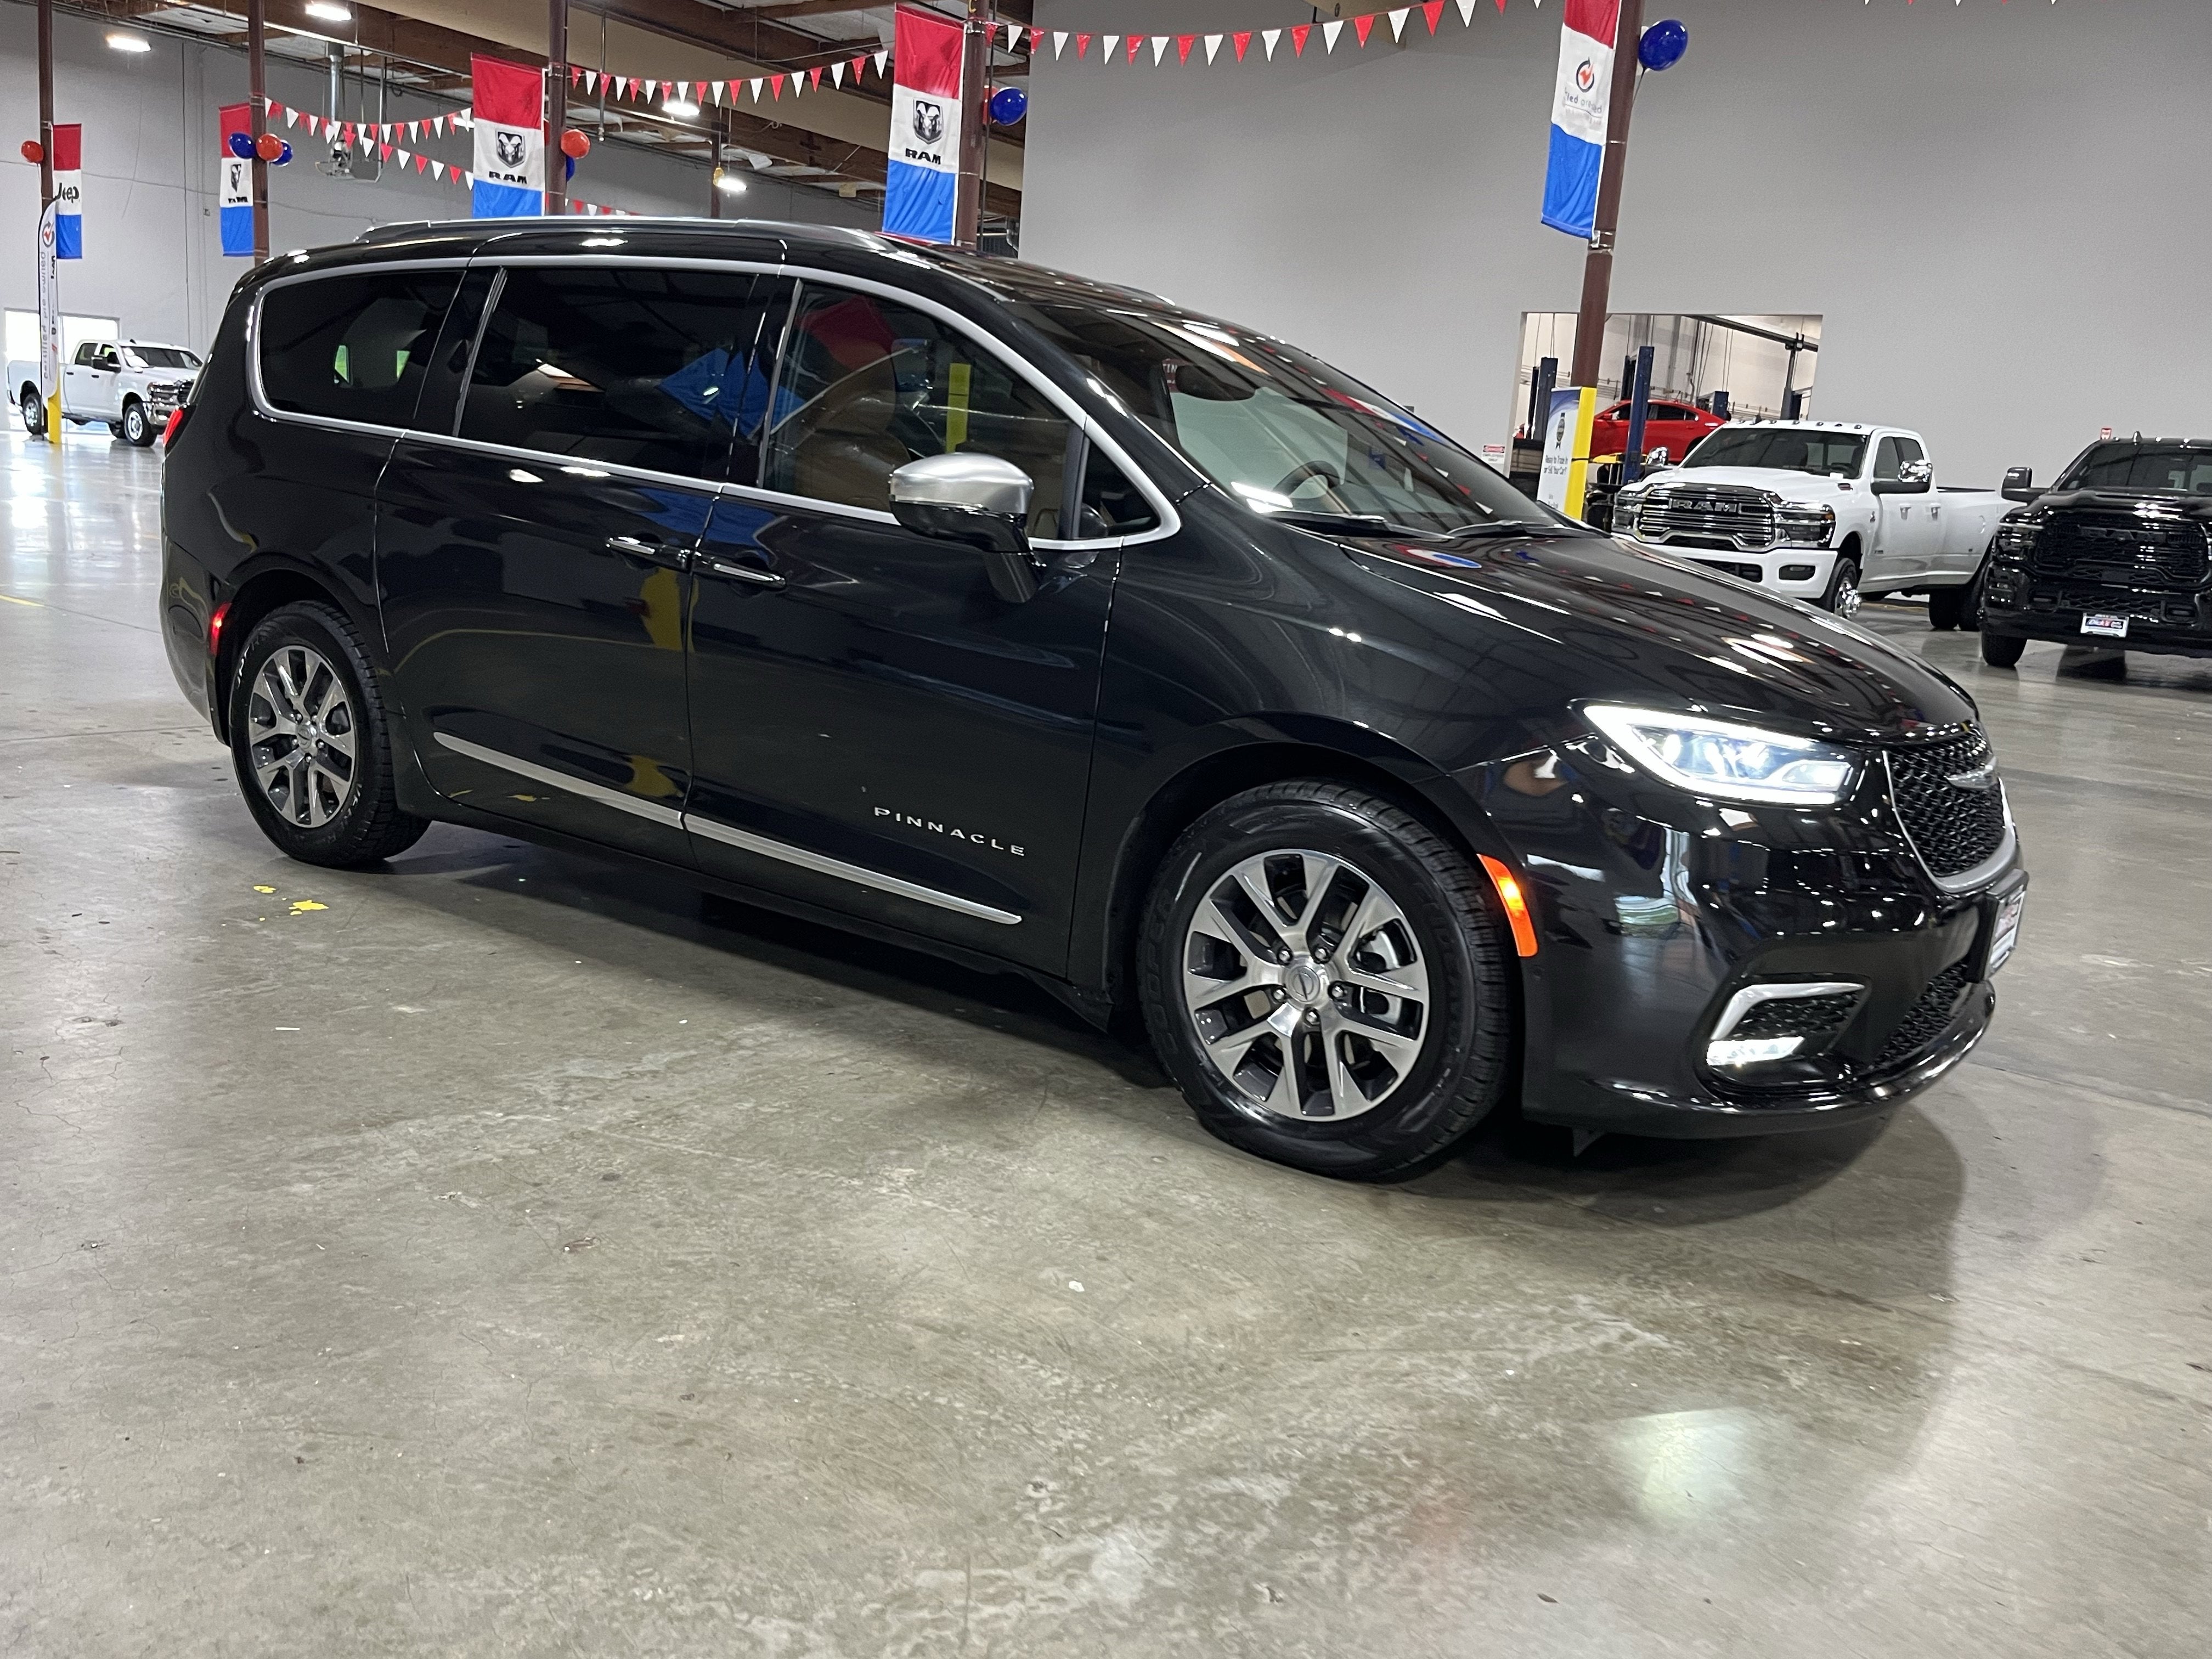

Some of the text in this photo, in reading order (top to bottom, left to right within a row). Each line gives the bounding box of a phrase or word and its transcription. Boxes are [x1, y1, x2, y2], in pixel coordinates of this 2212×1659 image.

[905, 148, 941, 165] RAM
[489, 171, 528, 185] RAM
[1672, 499, 1737, 512] RAM
[874, 806, 1025, 856] PINNACLE
